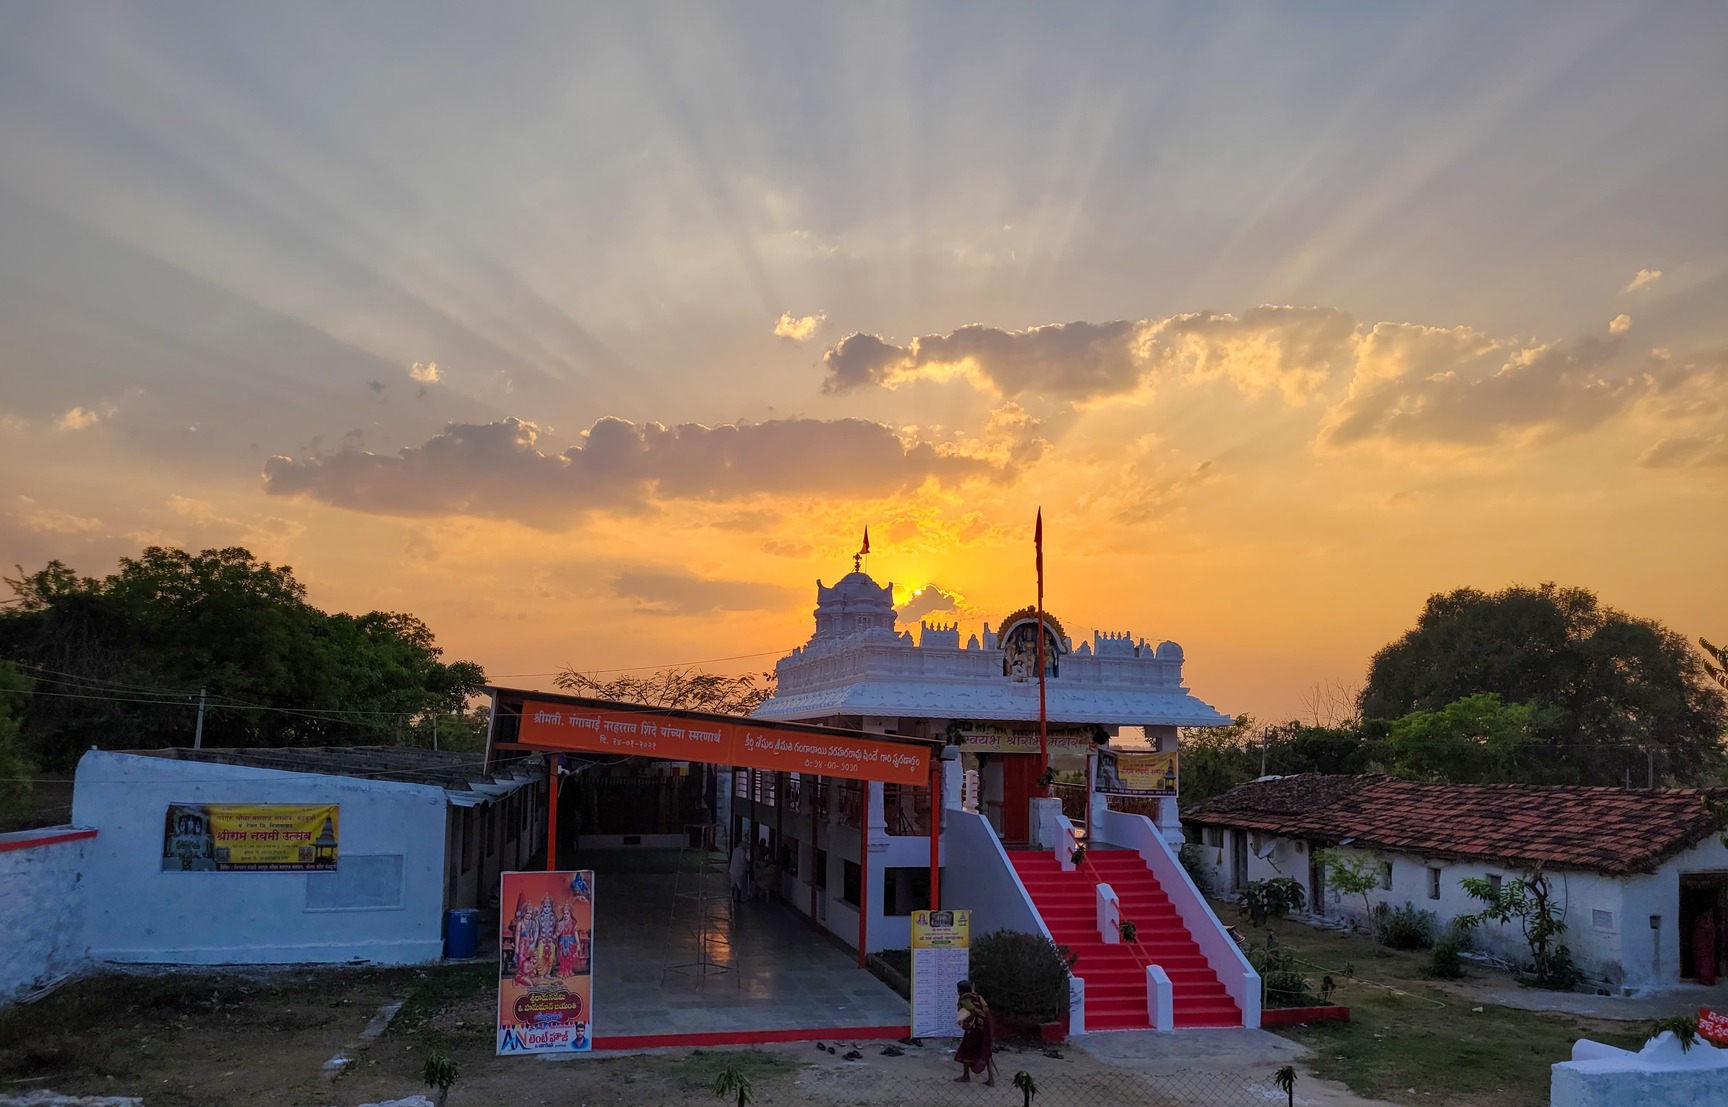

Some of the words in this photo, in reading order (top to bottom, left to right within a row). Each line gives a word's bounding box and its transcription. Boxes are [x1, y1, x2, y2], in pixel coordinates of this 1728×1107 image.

[569, 713, 600, 732] गंगाबाई
[603, 720, 637, 735] नरहरराव
[640, 720, 657, 737] शिंदे
[660, 724, 685, 740] यांच्या
[688, 729, 722, 743] स्मरणार्थ
[216, 828, 247, 842] श्रीराम
[250, 828, 279, 842] नवमी
[282, 829, 312, 842] उत्सव
